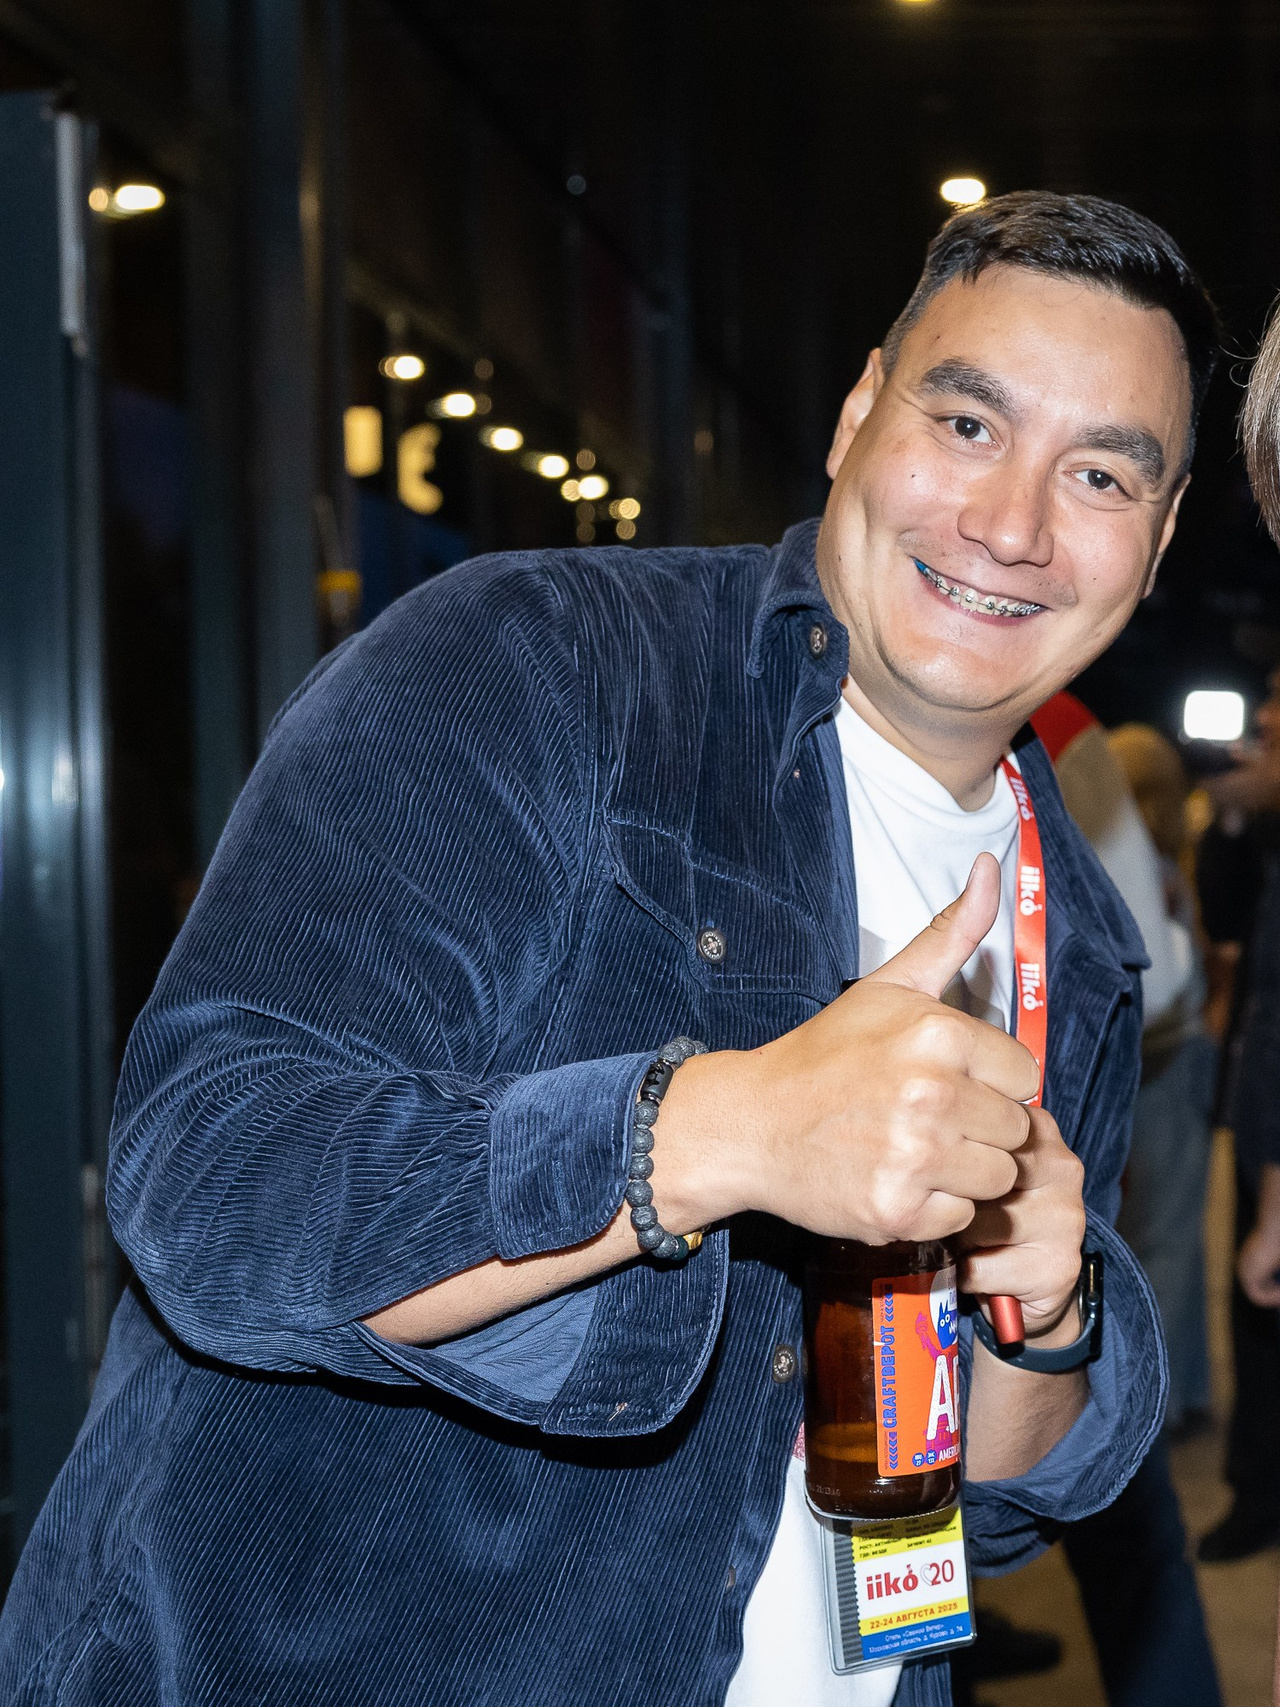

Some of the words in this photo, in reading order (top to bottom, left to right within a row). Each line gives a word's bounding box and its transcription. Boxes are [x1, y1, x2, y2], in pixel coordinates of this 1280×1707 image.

[880, 1325, 897, 1429] CRAFTDEPOT
[929, 1559, 954, 1586] 20
[869, 1617, 893, 1629] 22-24
[896, 1608, 935, 1623] АВГУСТА
[937, 1602, 958, 1613] 2025
